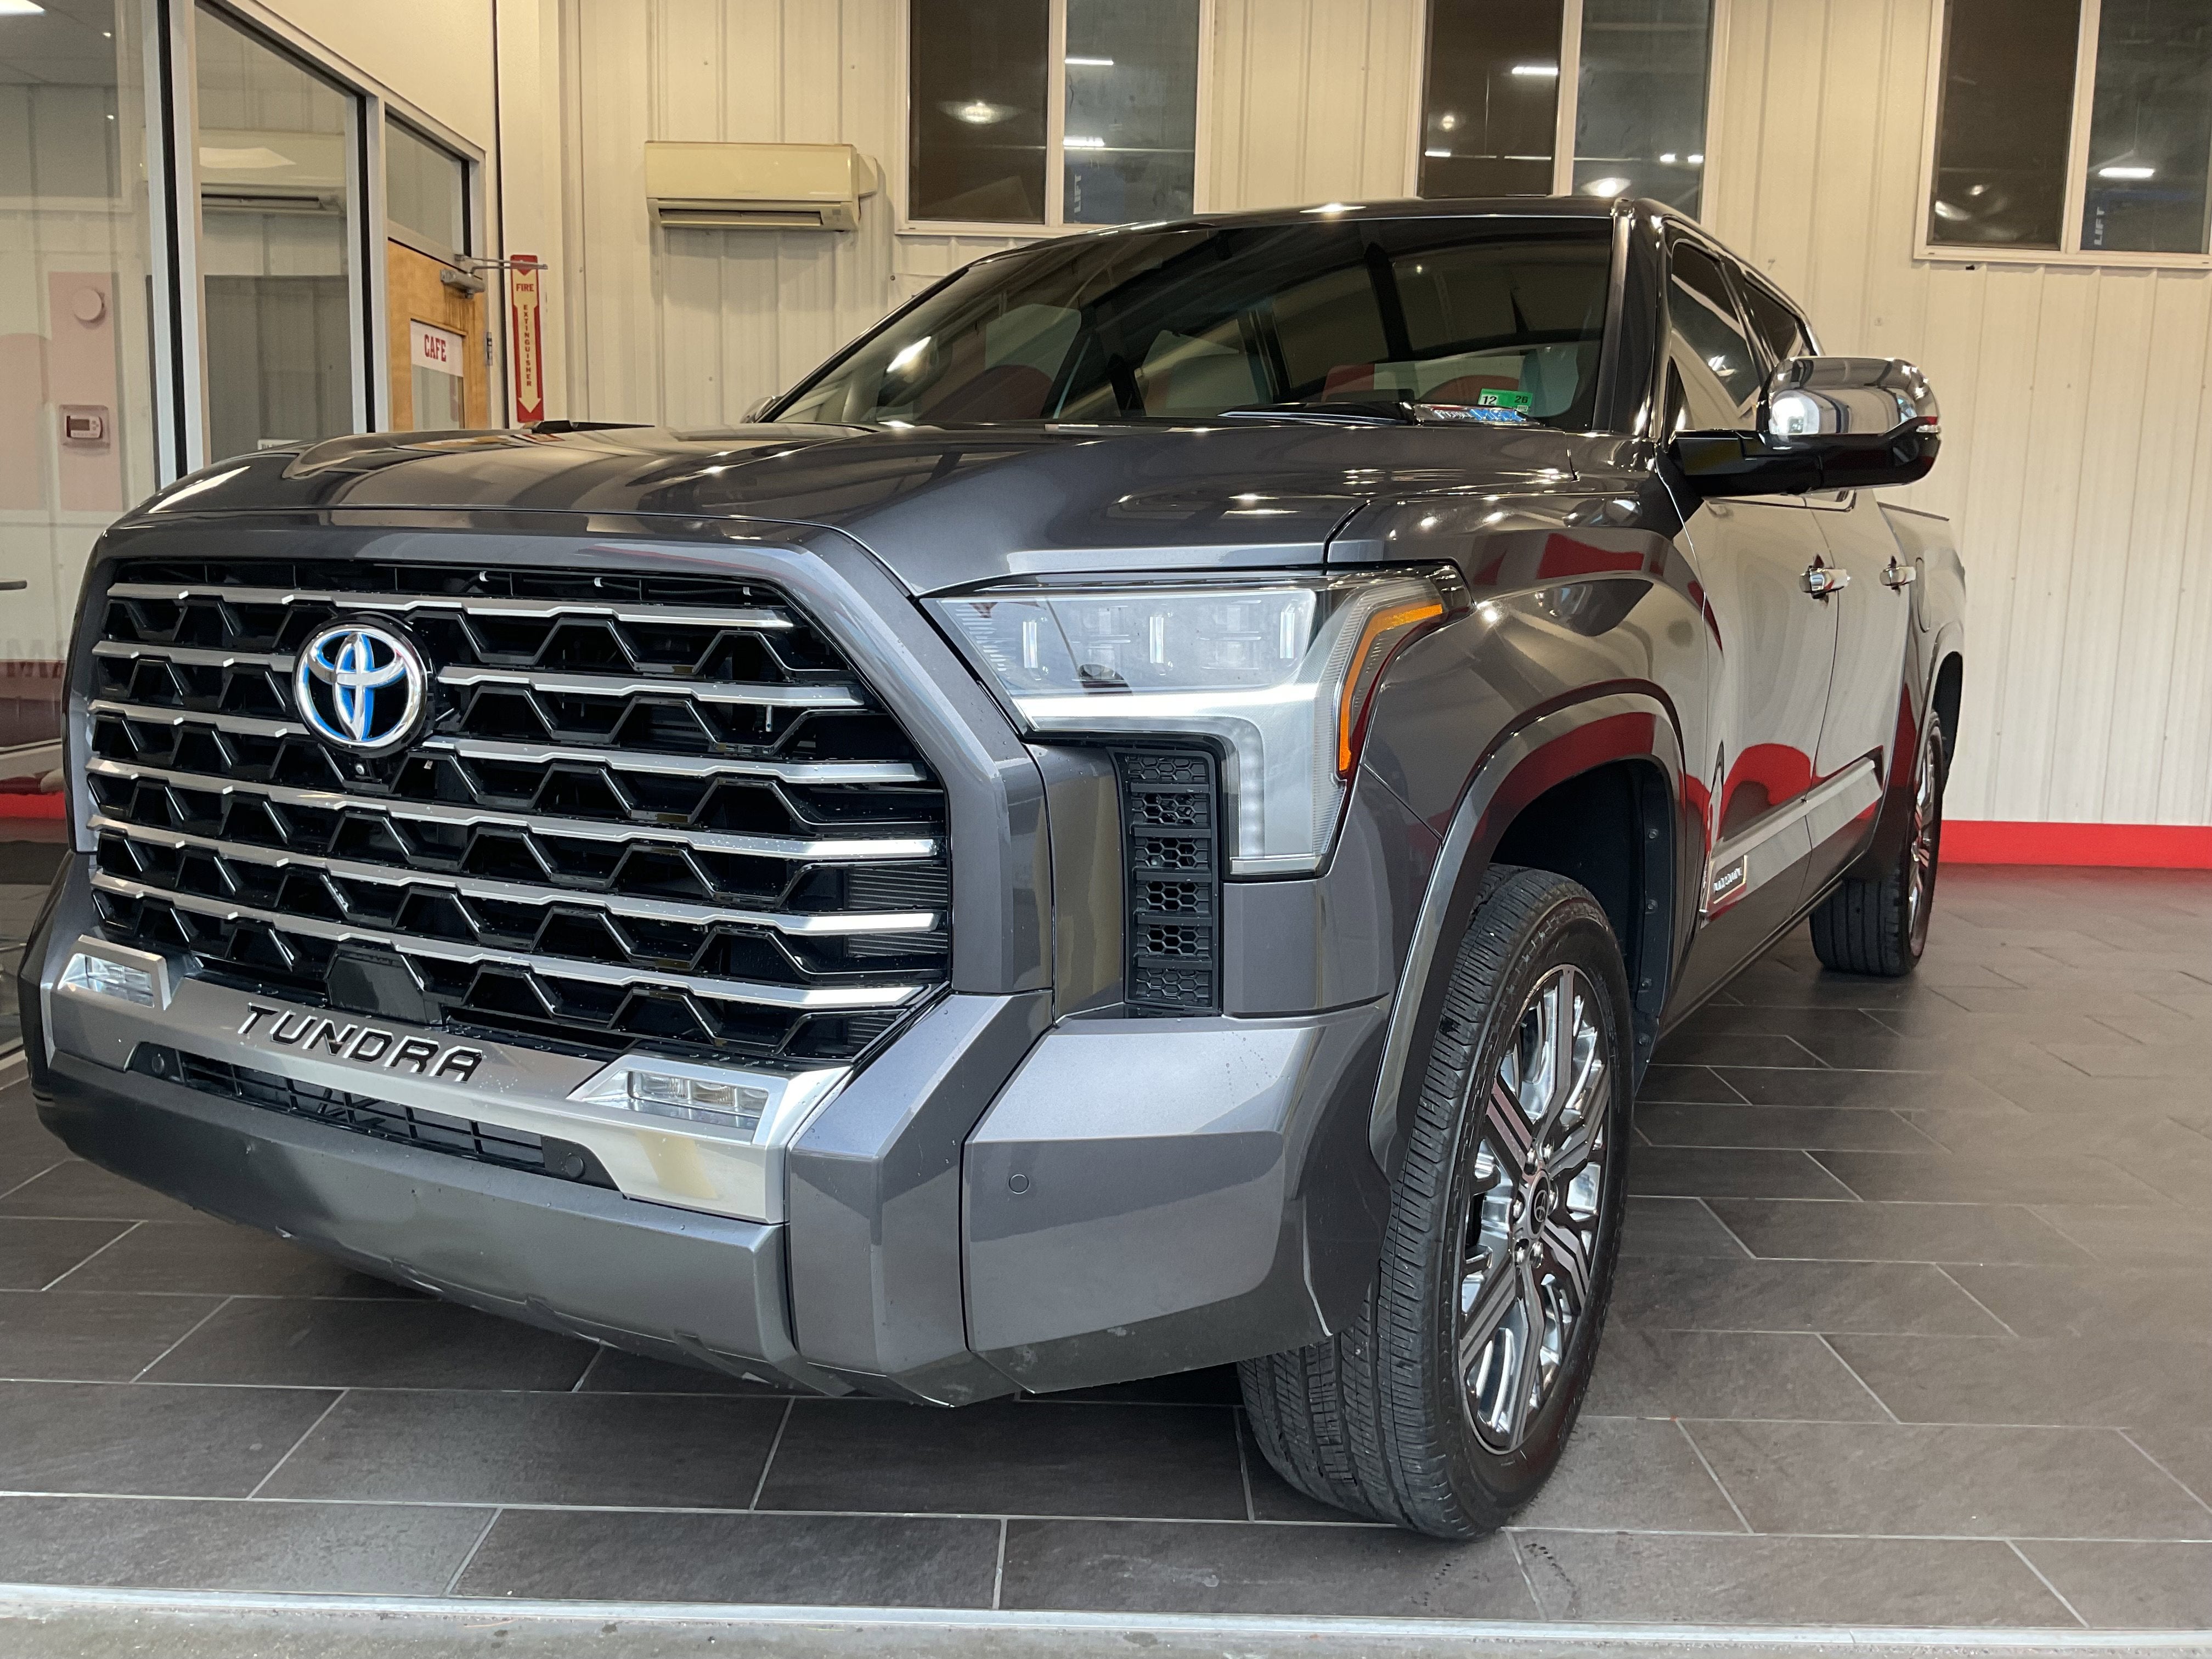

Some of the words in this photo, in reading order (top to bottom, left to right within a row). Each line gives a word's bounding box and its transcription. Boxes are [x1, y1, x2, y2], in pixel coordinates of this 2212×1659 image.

[2094, 206, 2105, 246] LIFT
[516, 283, 534, 292] FIRE
[424, 334, 447, 362] CAFE
[523, 304, 532, 387] EXTINGUISHER
[1482, 395, 1497, 405] 12
[238, 1002, 483, 1084] TUNDRA
